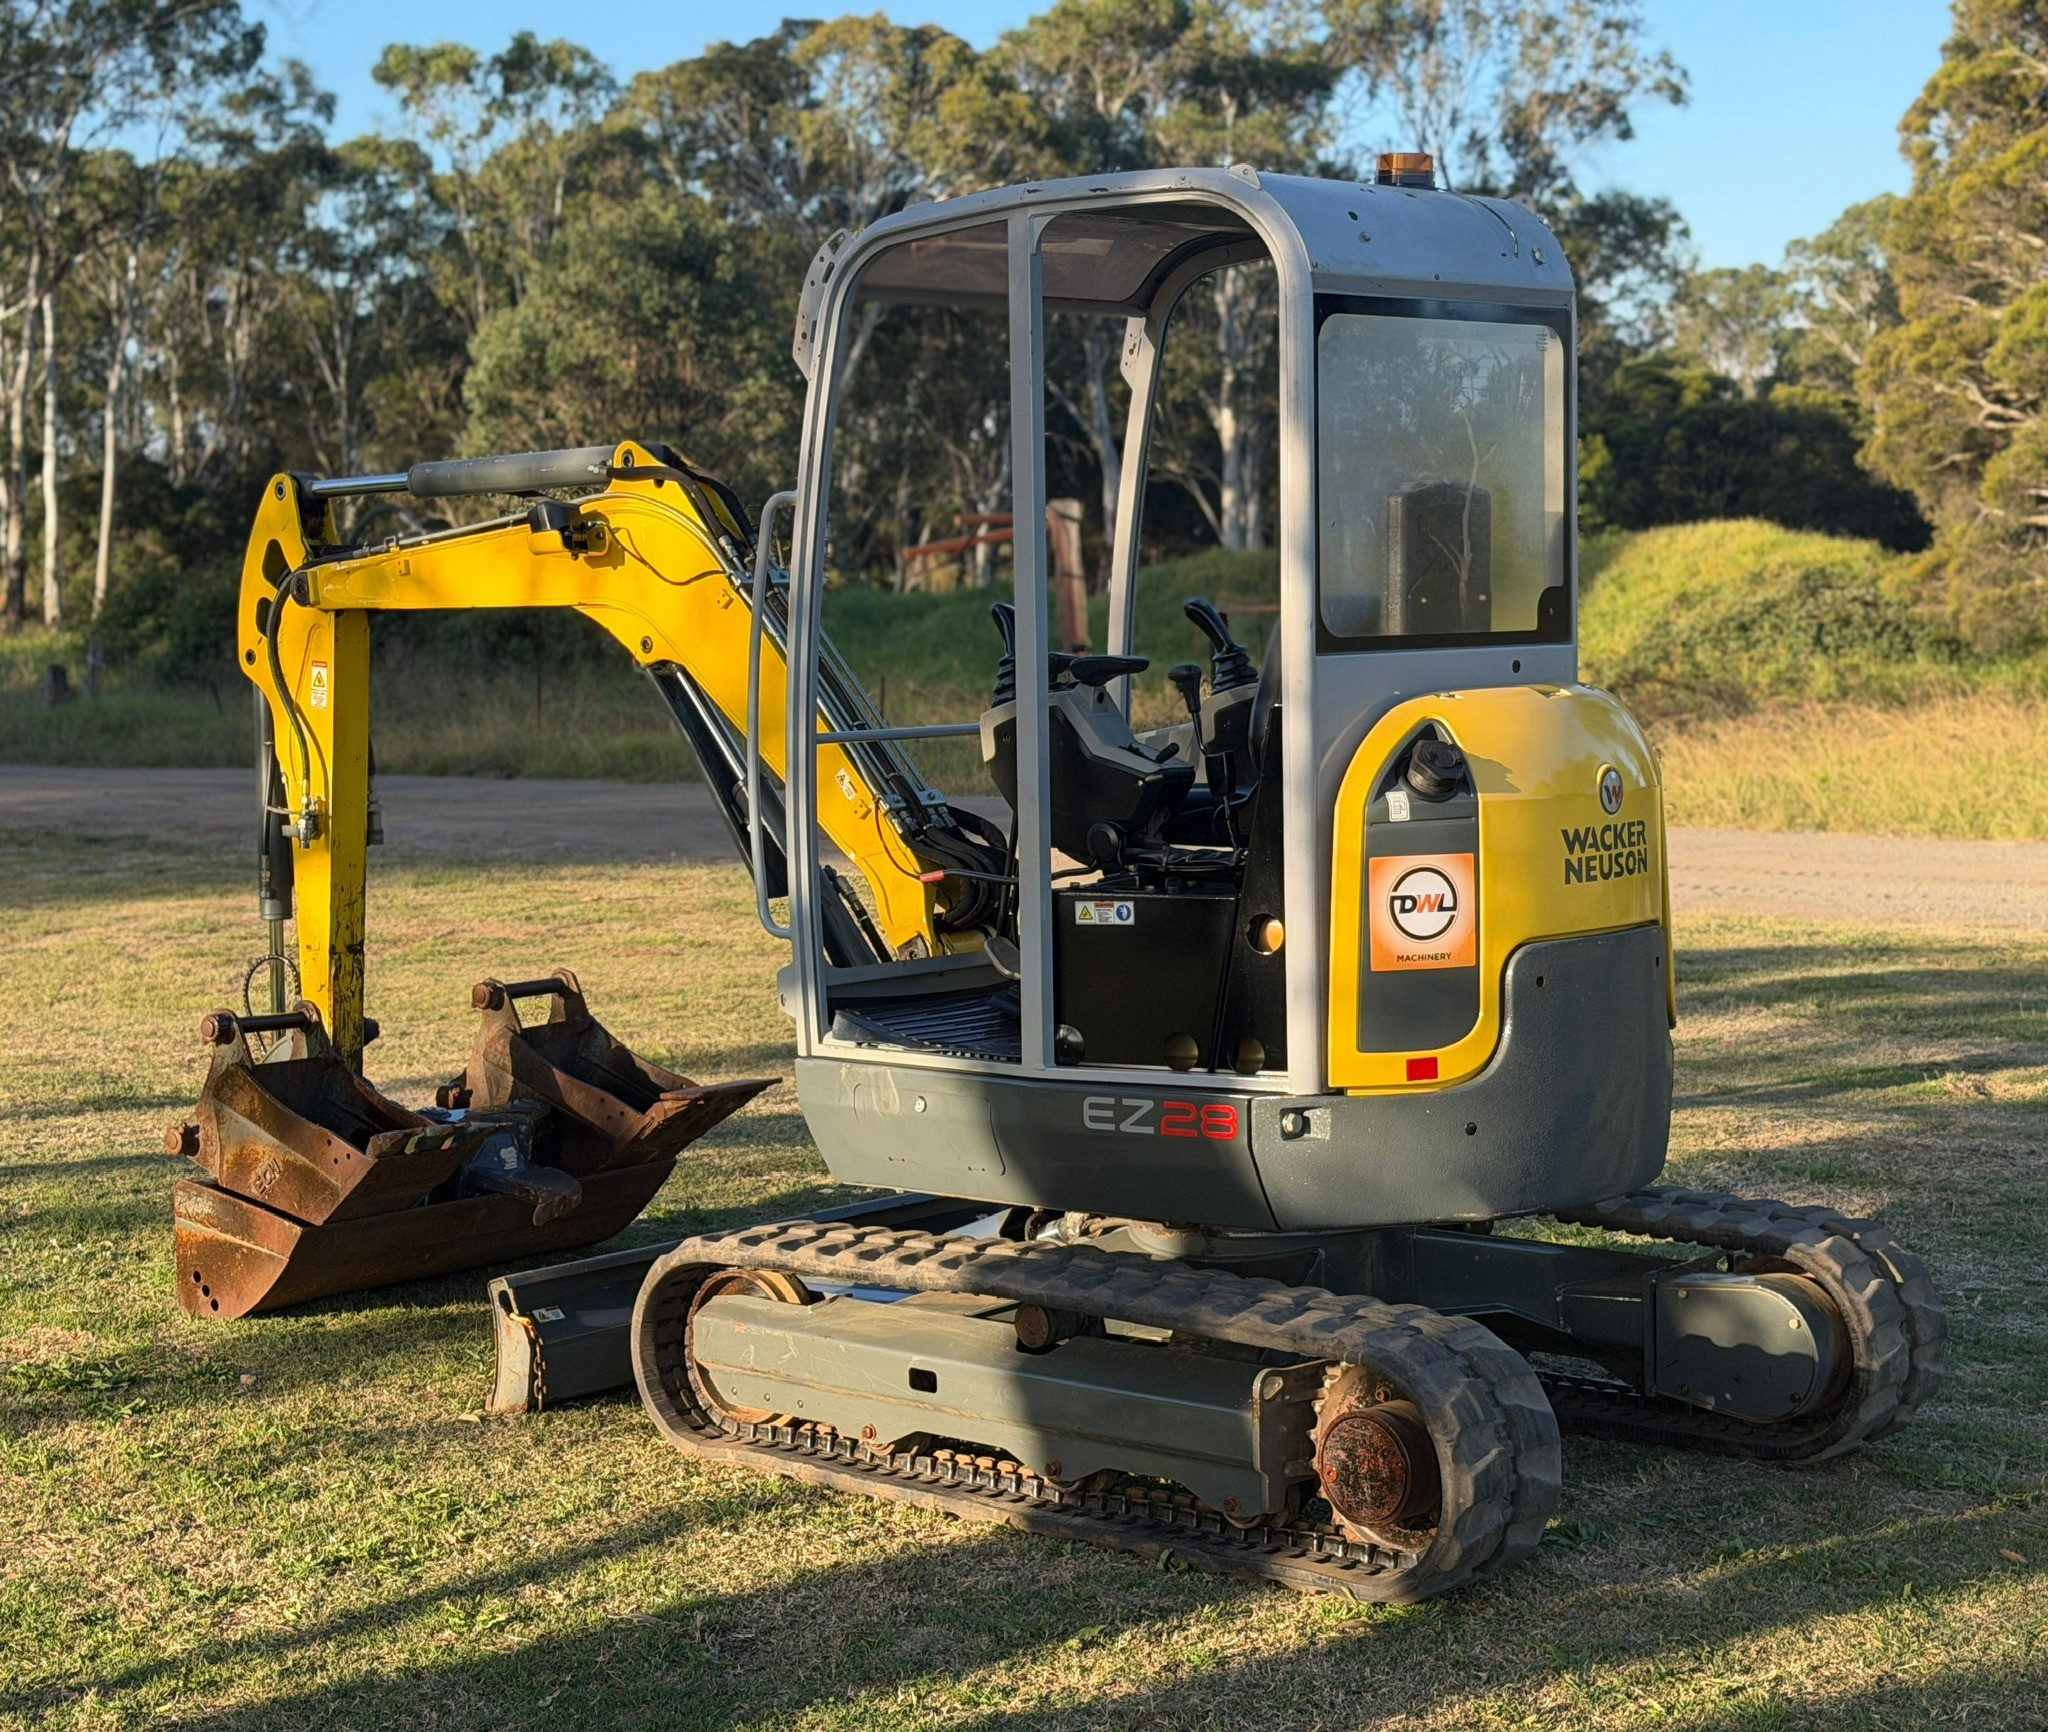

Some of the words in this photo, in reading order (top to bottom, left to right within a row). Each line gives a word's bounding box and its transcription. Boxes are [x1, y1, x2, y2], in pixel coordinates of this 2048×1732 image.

[1560, 820, 1647, 855] WACKER
[1564, 847, 1648, 885] NEUSON
[1389, 893, 1458, 914] DWL
[1396, 952, 1453, 963] MACHINERY
[1082, 1096, 1239, 1141] EZ28
